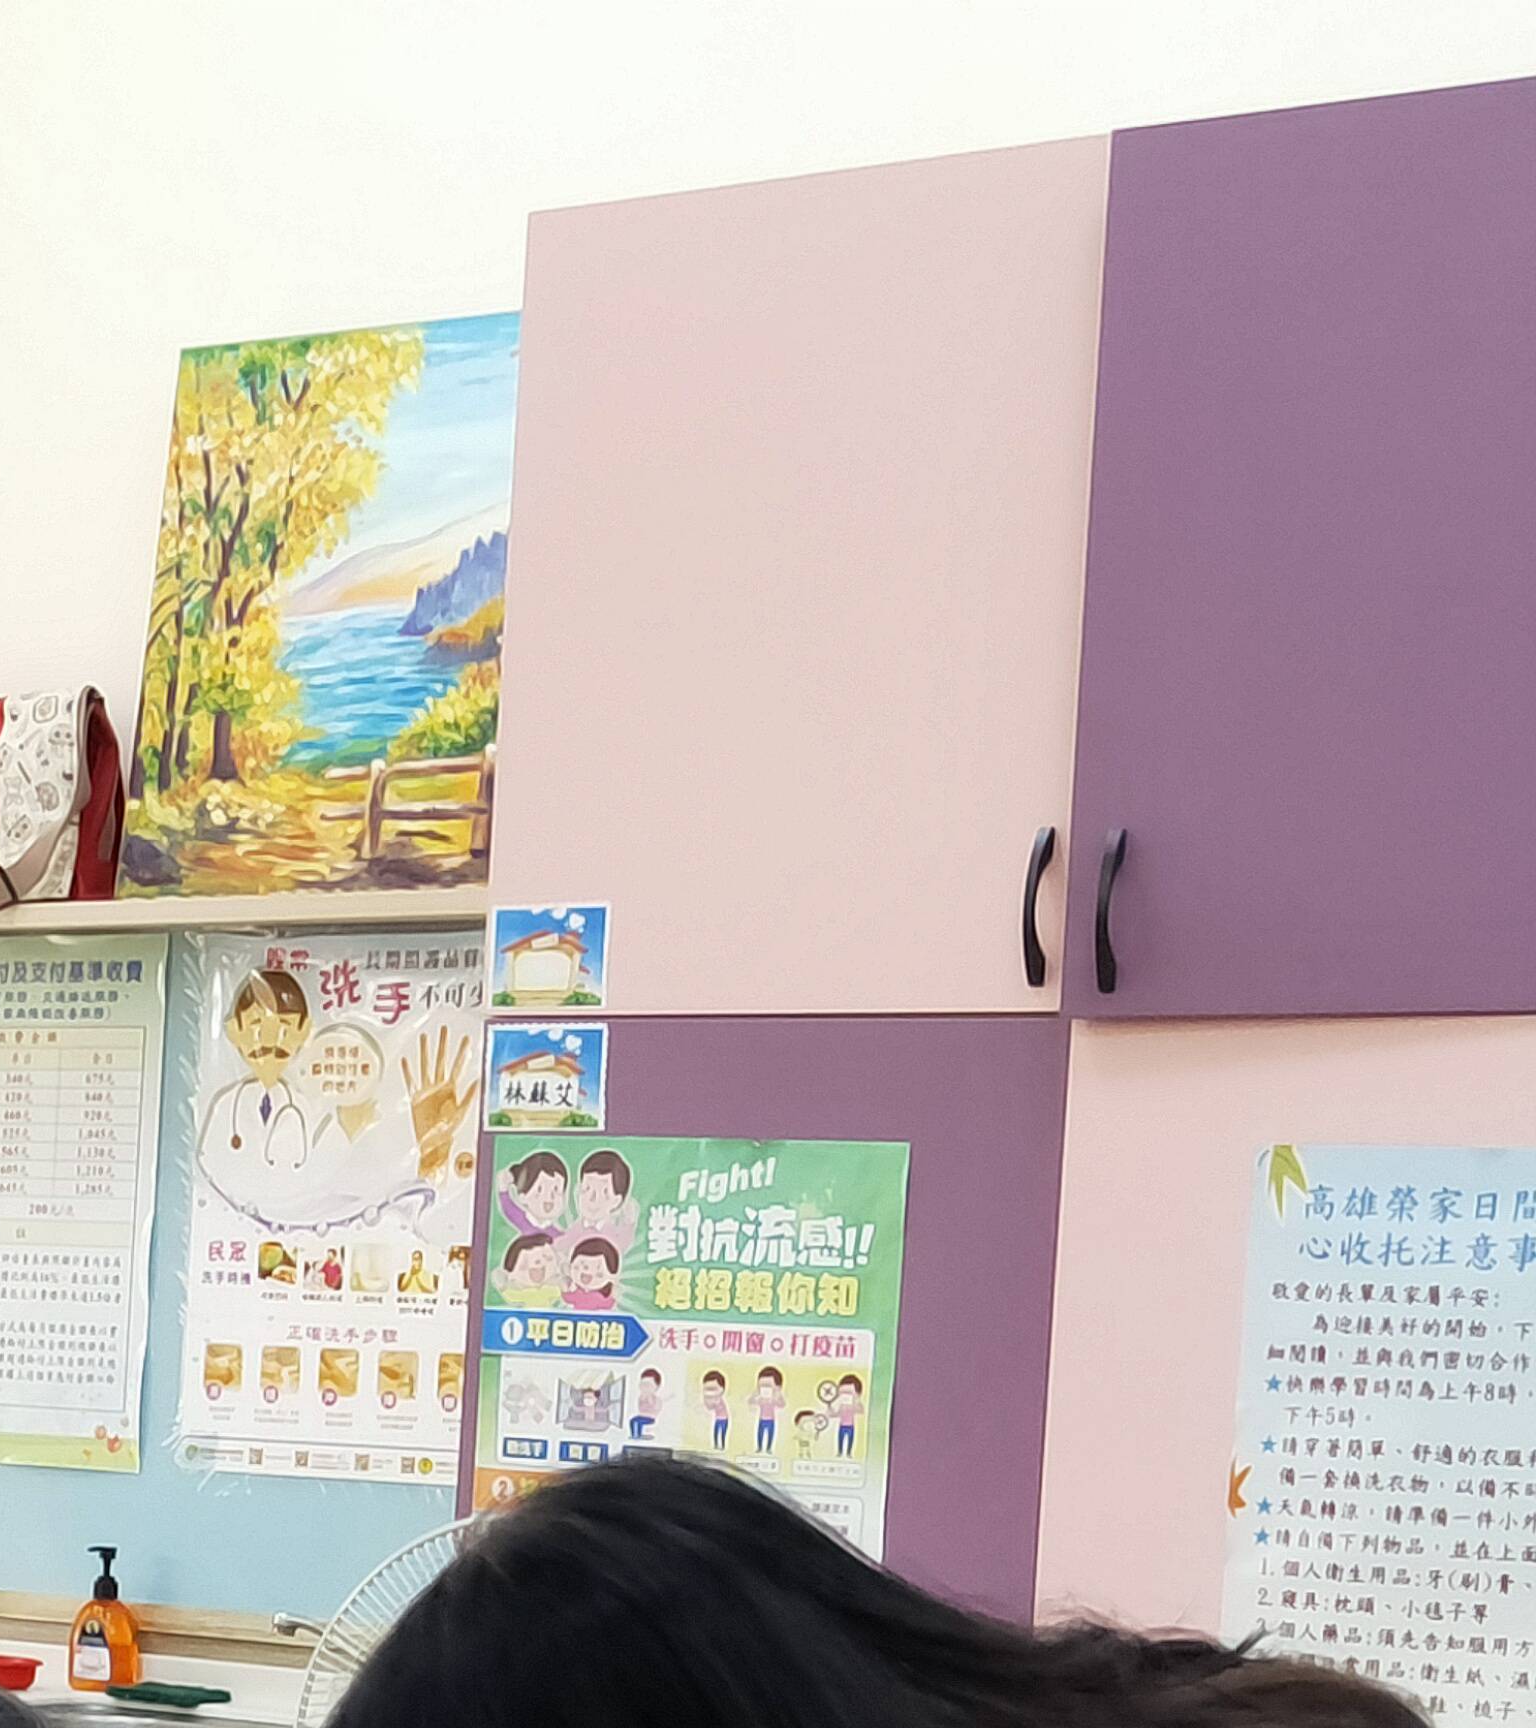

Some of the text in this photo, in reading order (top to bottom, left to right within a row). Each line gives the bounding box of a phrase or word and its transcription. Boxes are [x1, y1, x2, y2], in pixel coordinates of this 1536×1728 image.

[676, 1155, 778, 1203] Fight!
[1303, 1183, 1536, 1224] 高雄榮家日間
[645, 1203, 877, 1270] 對抗流感!!
[653, 1266, 862, 1317] 絕招報你知
[526, 1318, 627, 1351] 平日防治
